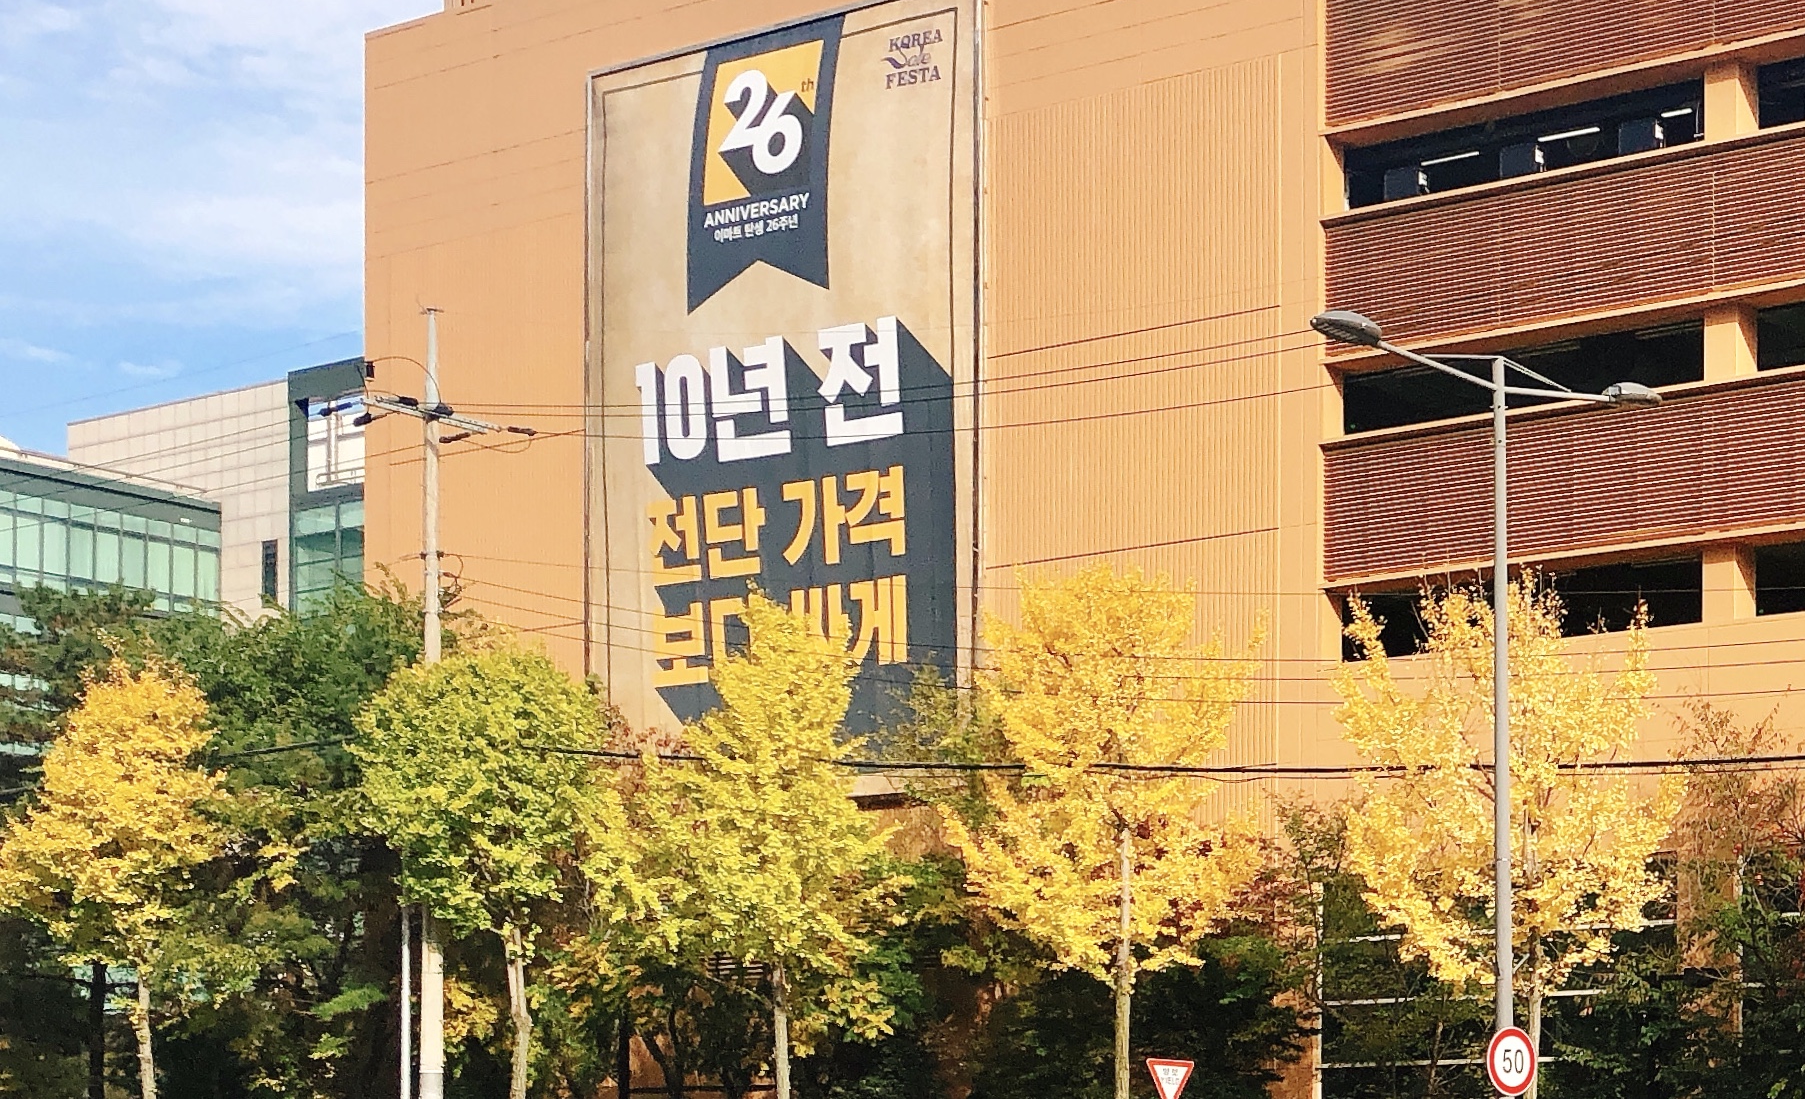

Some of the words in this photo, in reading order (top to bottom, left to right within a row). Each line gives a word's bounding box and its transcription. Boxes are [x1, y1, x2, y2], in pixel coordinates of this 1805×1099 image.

[888, 28, 943, 52] KOREA
[885, 65, 941, 89] FESTA
[703, 192, 810, 229] ANNIVERSARY
[713, 226, 743, 243] 이마트
[766, 213, 799, 233] 26주년
[635, 335, 792, 465] 10년
[817, 316, 904, 447] 전
[647, 486, 766, 587] 전단
[782, 465, 907, 566] 가격
[1502, 1049, 1524, 1074] 50
